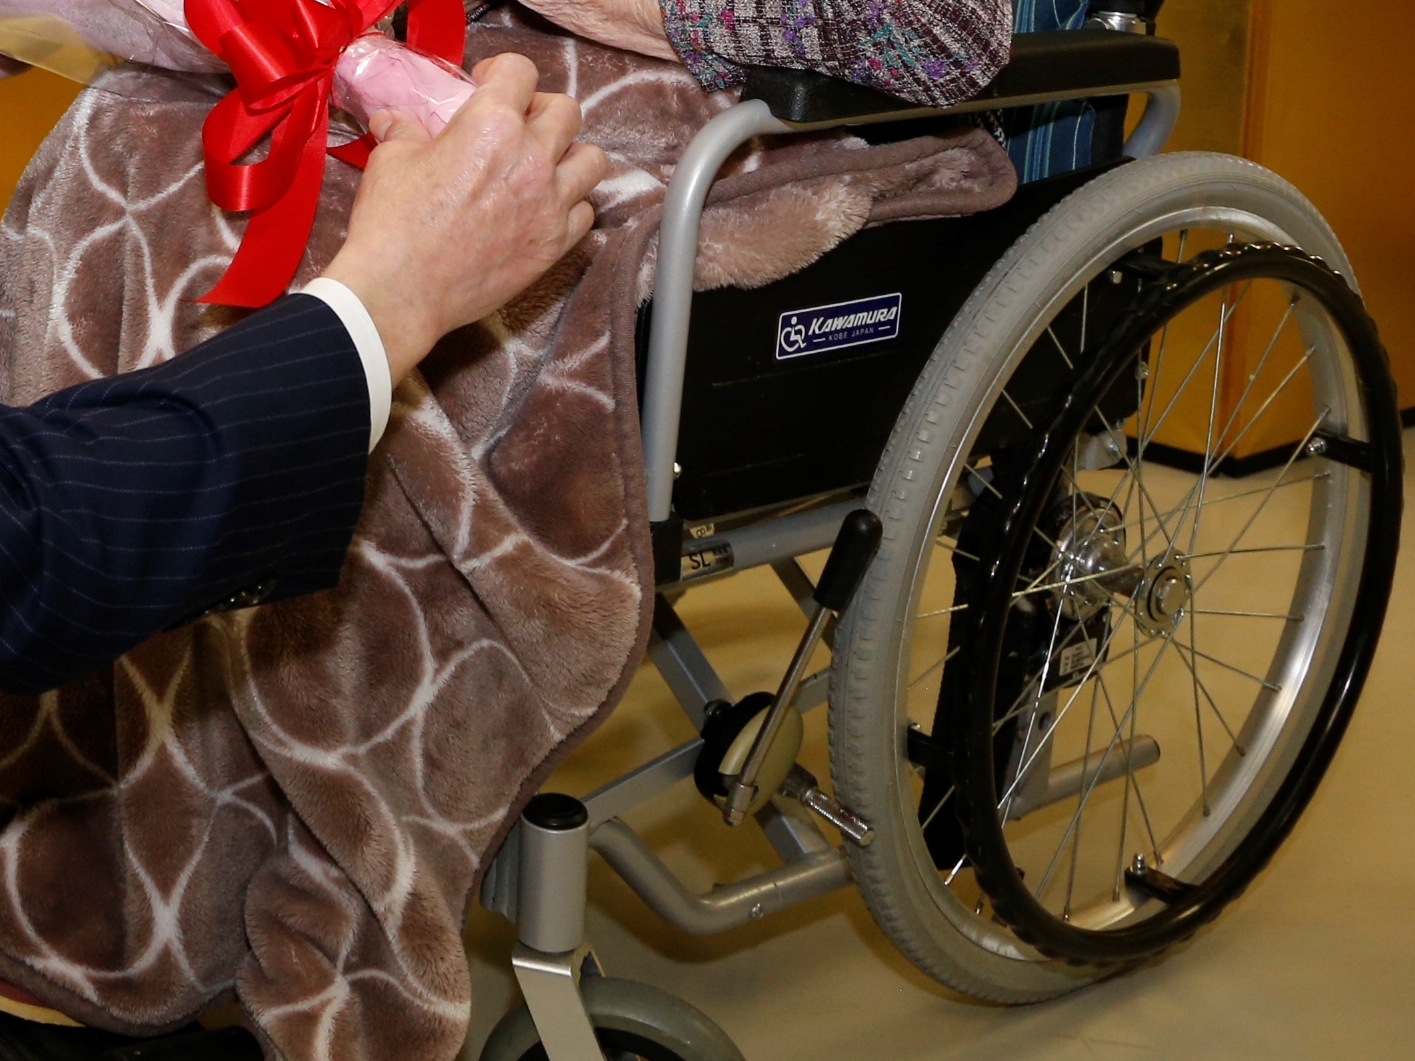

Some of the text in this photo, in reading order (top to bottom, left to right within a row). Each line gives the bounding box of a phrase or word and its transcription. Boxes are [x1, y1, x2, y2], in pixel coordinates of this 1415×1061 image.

[808, 306, 898, 335] KAWAMURA
[828, 327, 874, 341] KOBE JAPAN
